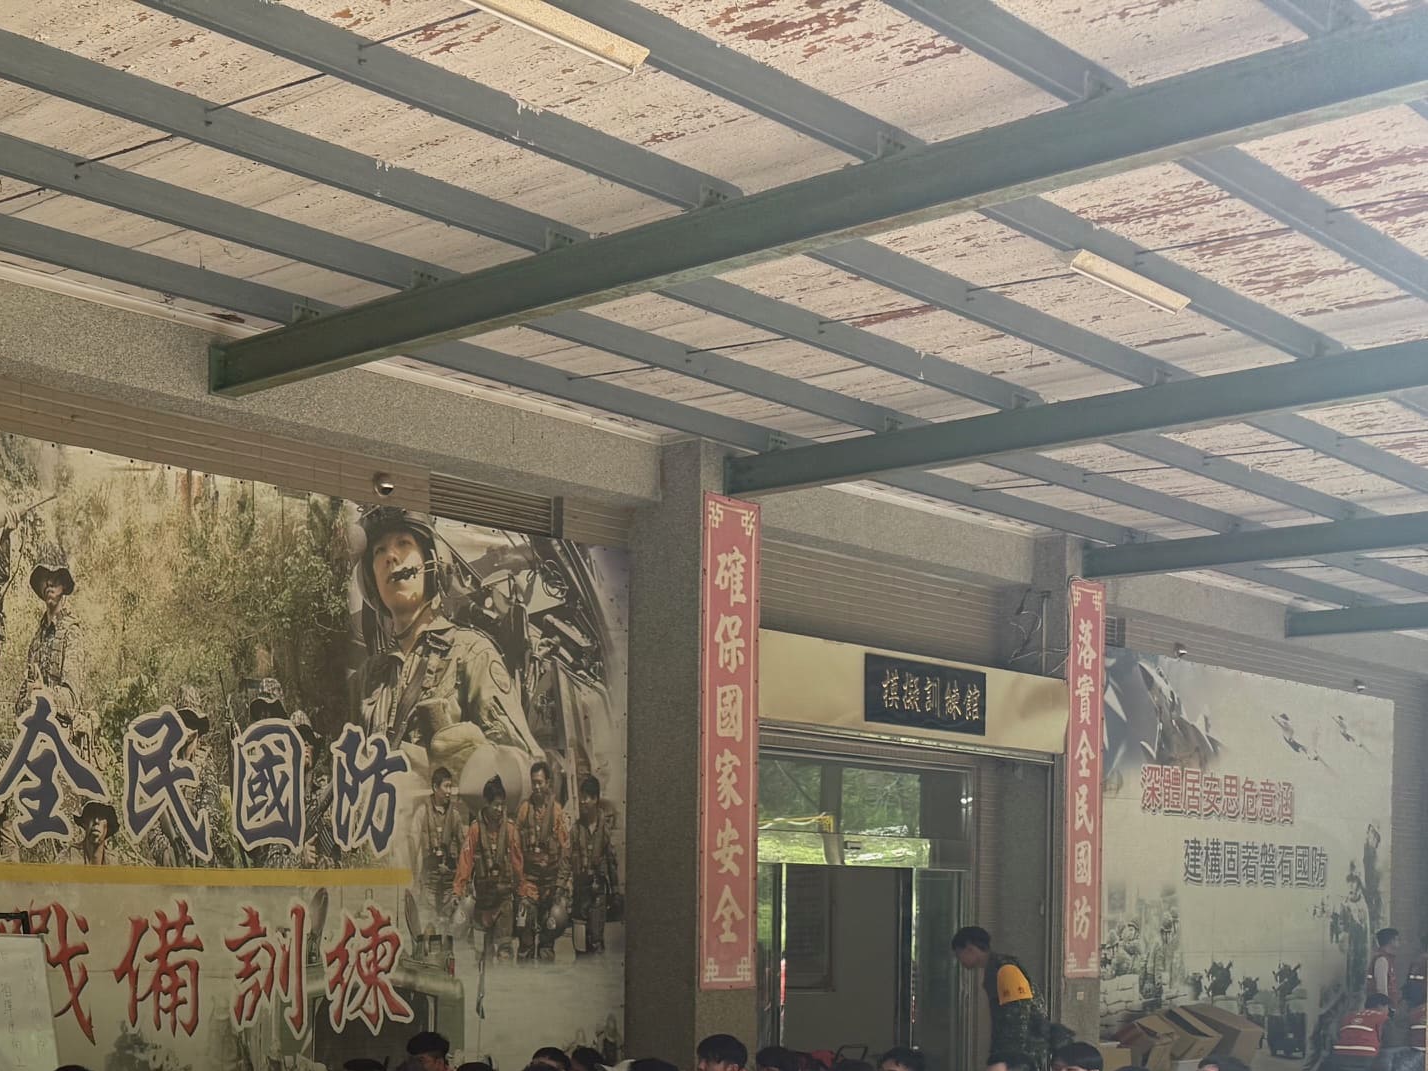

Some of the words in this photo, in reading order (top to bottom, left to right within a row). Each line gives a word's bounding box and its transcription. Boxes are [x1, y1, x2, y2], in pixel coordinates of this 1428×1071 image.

[712, 545, 747, 944] 確保國家安全
[1074, 618, 1097, 941] 落實全民國防
